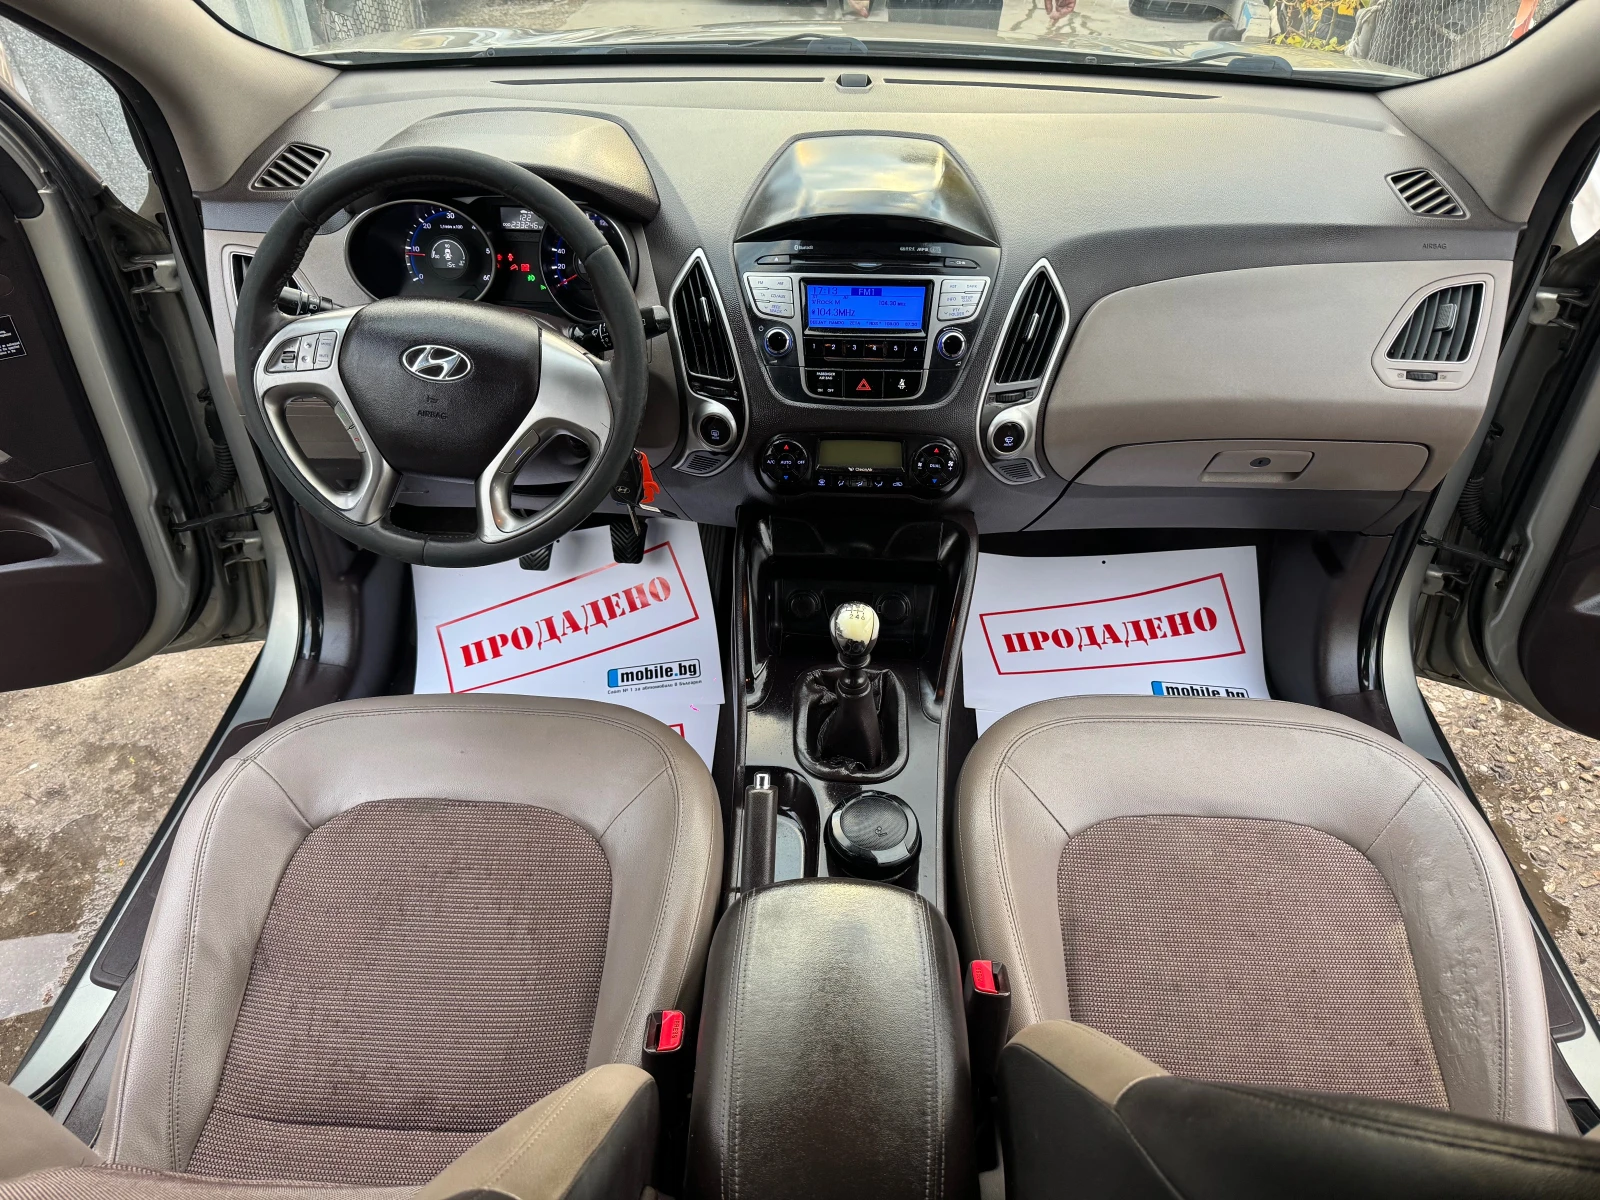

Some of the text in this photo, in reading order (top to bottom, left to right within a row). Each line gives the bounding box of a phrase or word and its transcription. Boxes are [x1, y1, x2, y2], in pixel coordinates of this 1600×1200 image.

[510, 221, 538, 229] 233246
[817, 308, 855, 317] 104.3MHz
[460, 576, 671, 667] ПРОДАДЕНО
[1002, 606, 1218, 653] ПРОДАДЕНО
[621, 663, 697, 682] mobile.bg
